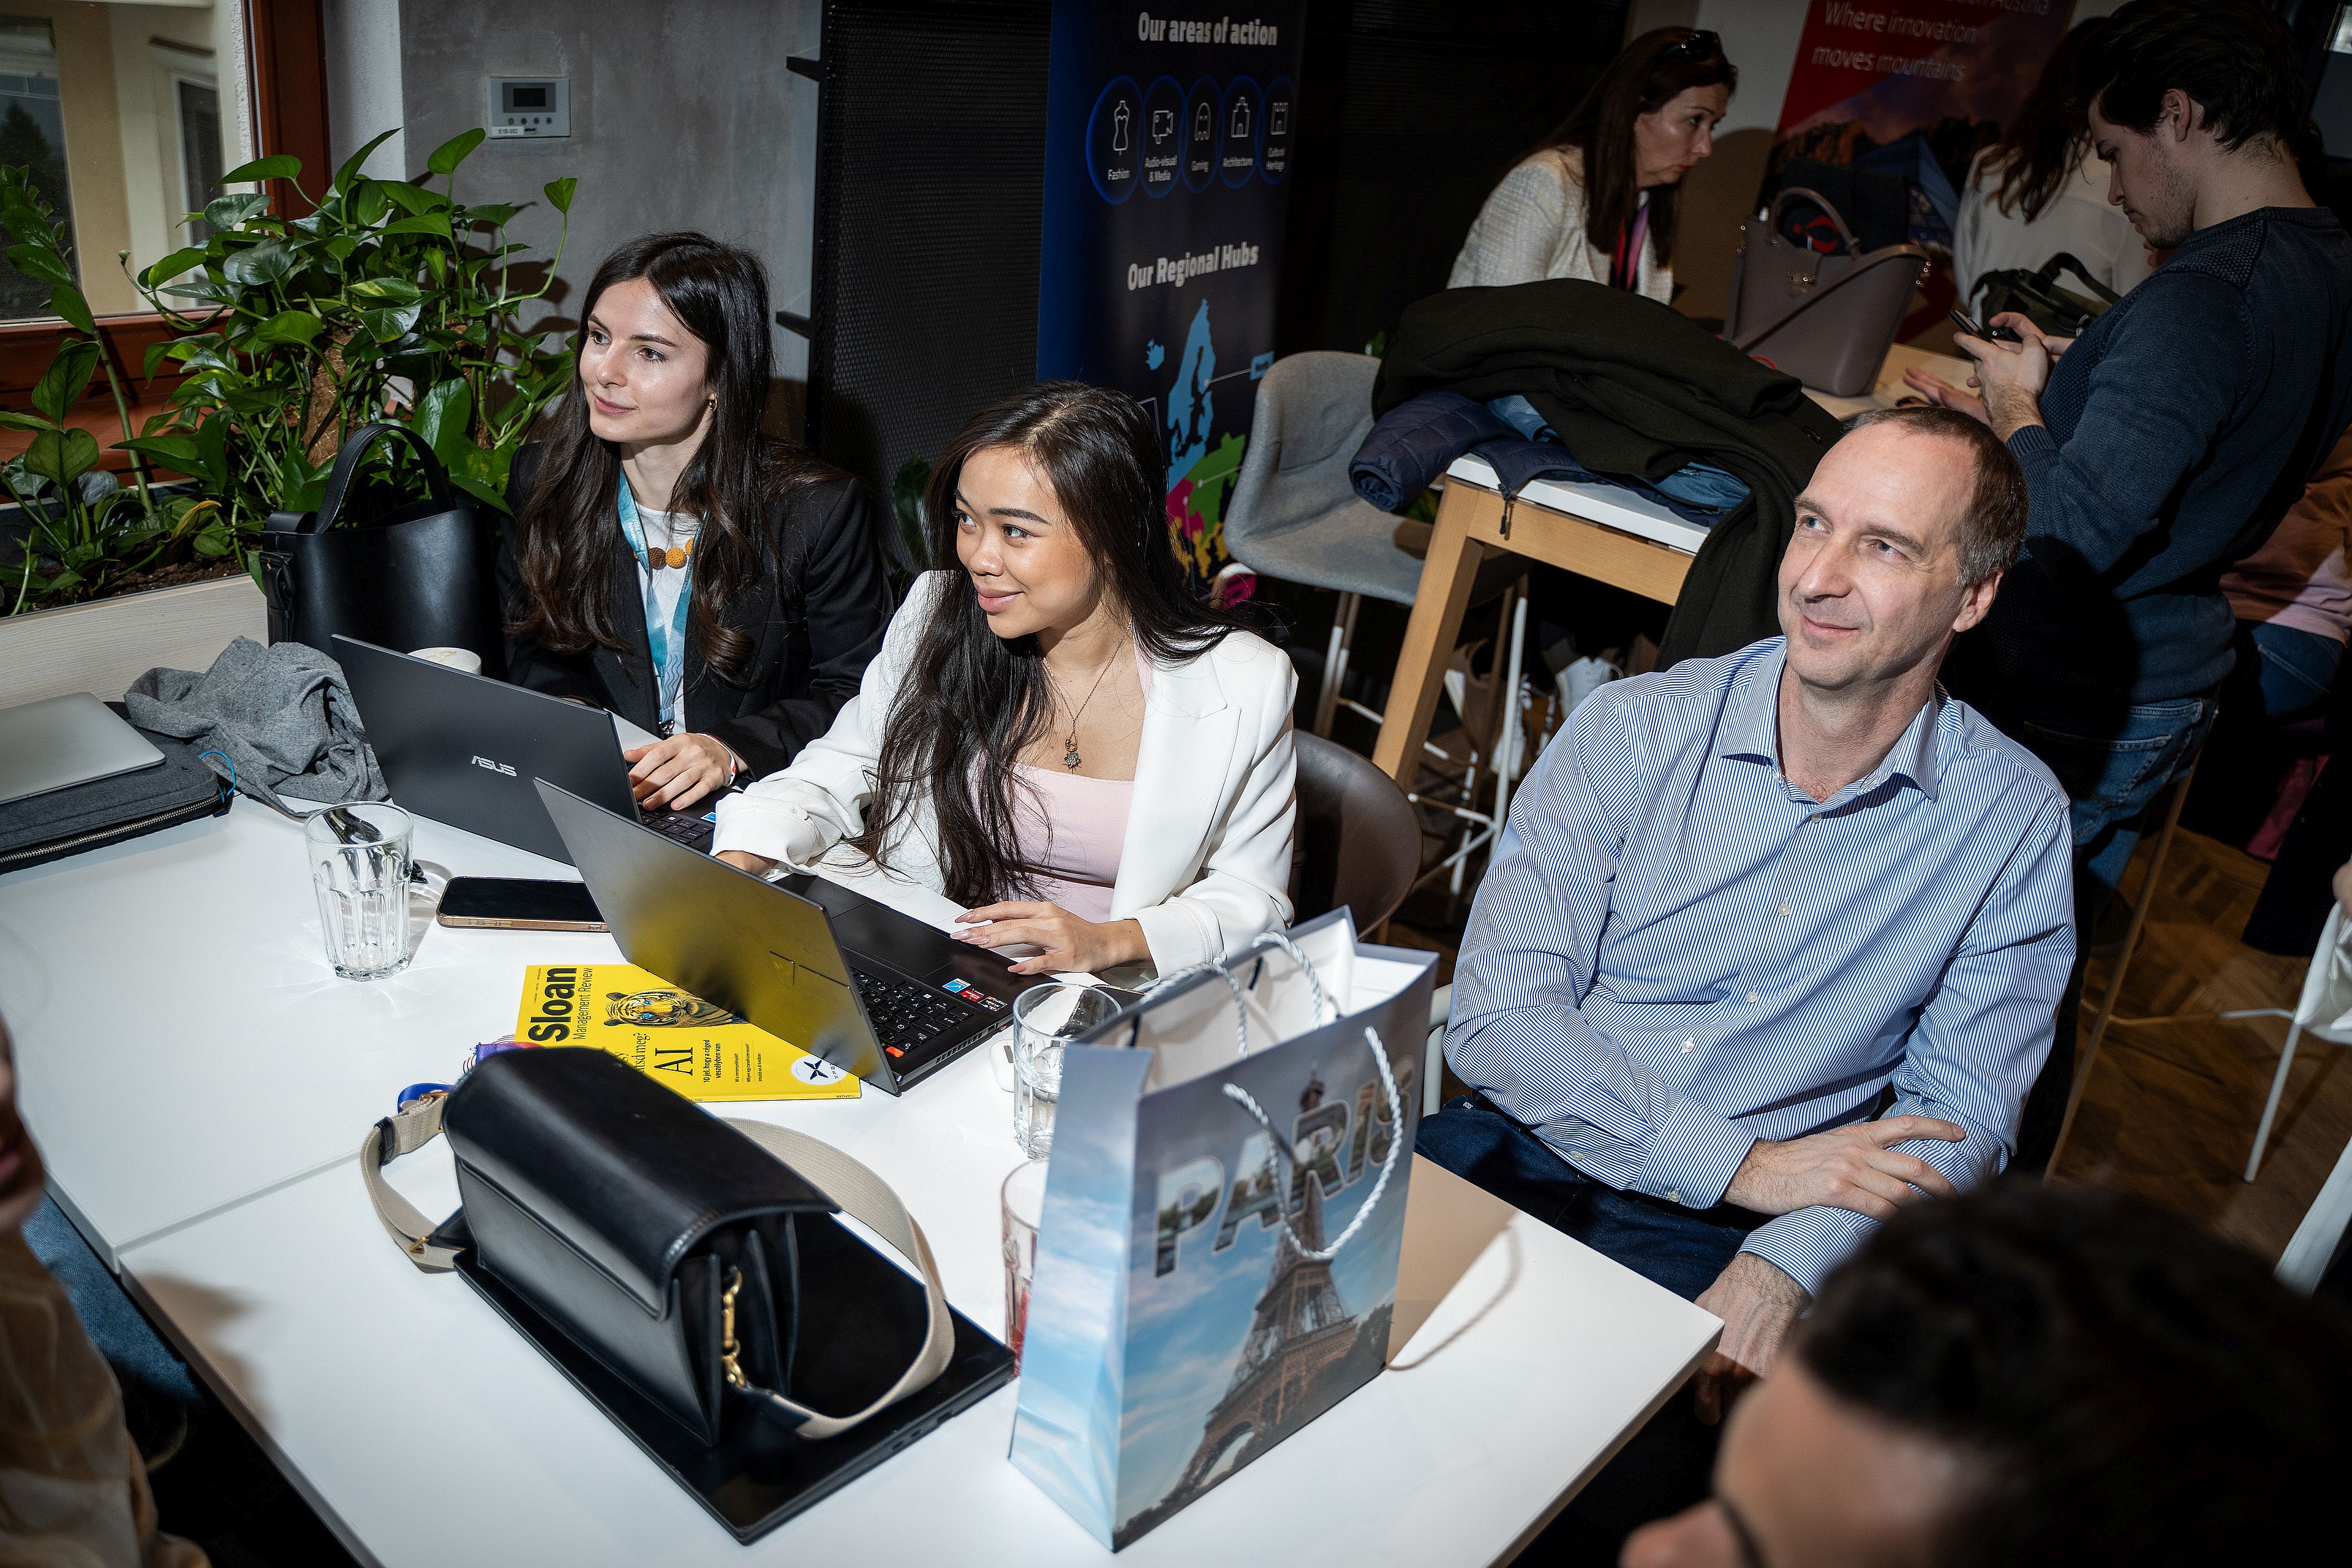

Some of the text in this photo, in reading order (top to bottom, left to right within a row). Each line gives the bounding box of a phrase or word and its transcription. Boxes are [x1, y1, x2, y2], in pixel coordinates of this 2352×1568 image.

[1137, 12, 1278, 46] Our areas of action
[1825, 1, 1979, 44] Where innovation
[1812, 46, 1966, 82] moves mountains
[1107, 168, 1130, 181] Fashion
[1144, 155, 1178, 168] Audio-visual
[1156, 170, 1171, 182] Media
[1127, 241, 1259, 291] Our Regional Hubs
[471, 755, 518, 777] ASUS
[527, 968, 578, 1042] Sloan
[572, 967, 594, 1040] Management Review
[633, 1032, 650, 1054] meg?
[703, 1039, 712, 1053] céged
[654, 1047, 694, 1076] AI
[703, 1058, 712, 1069] hogy
[714, 1052, 723, 1079] veszélyben
[1154, 1054, 1415, 1279] PARIS
